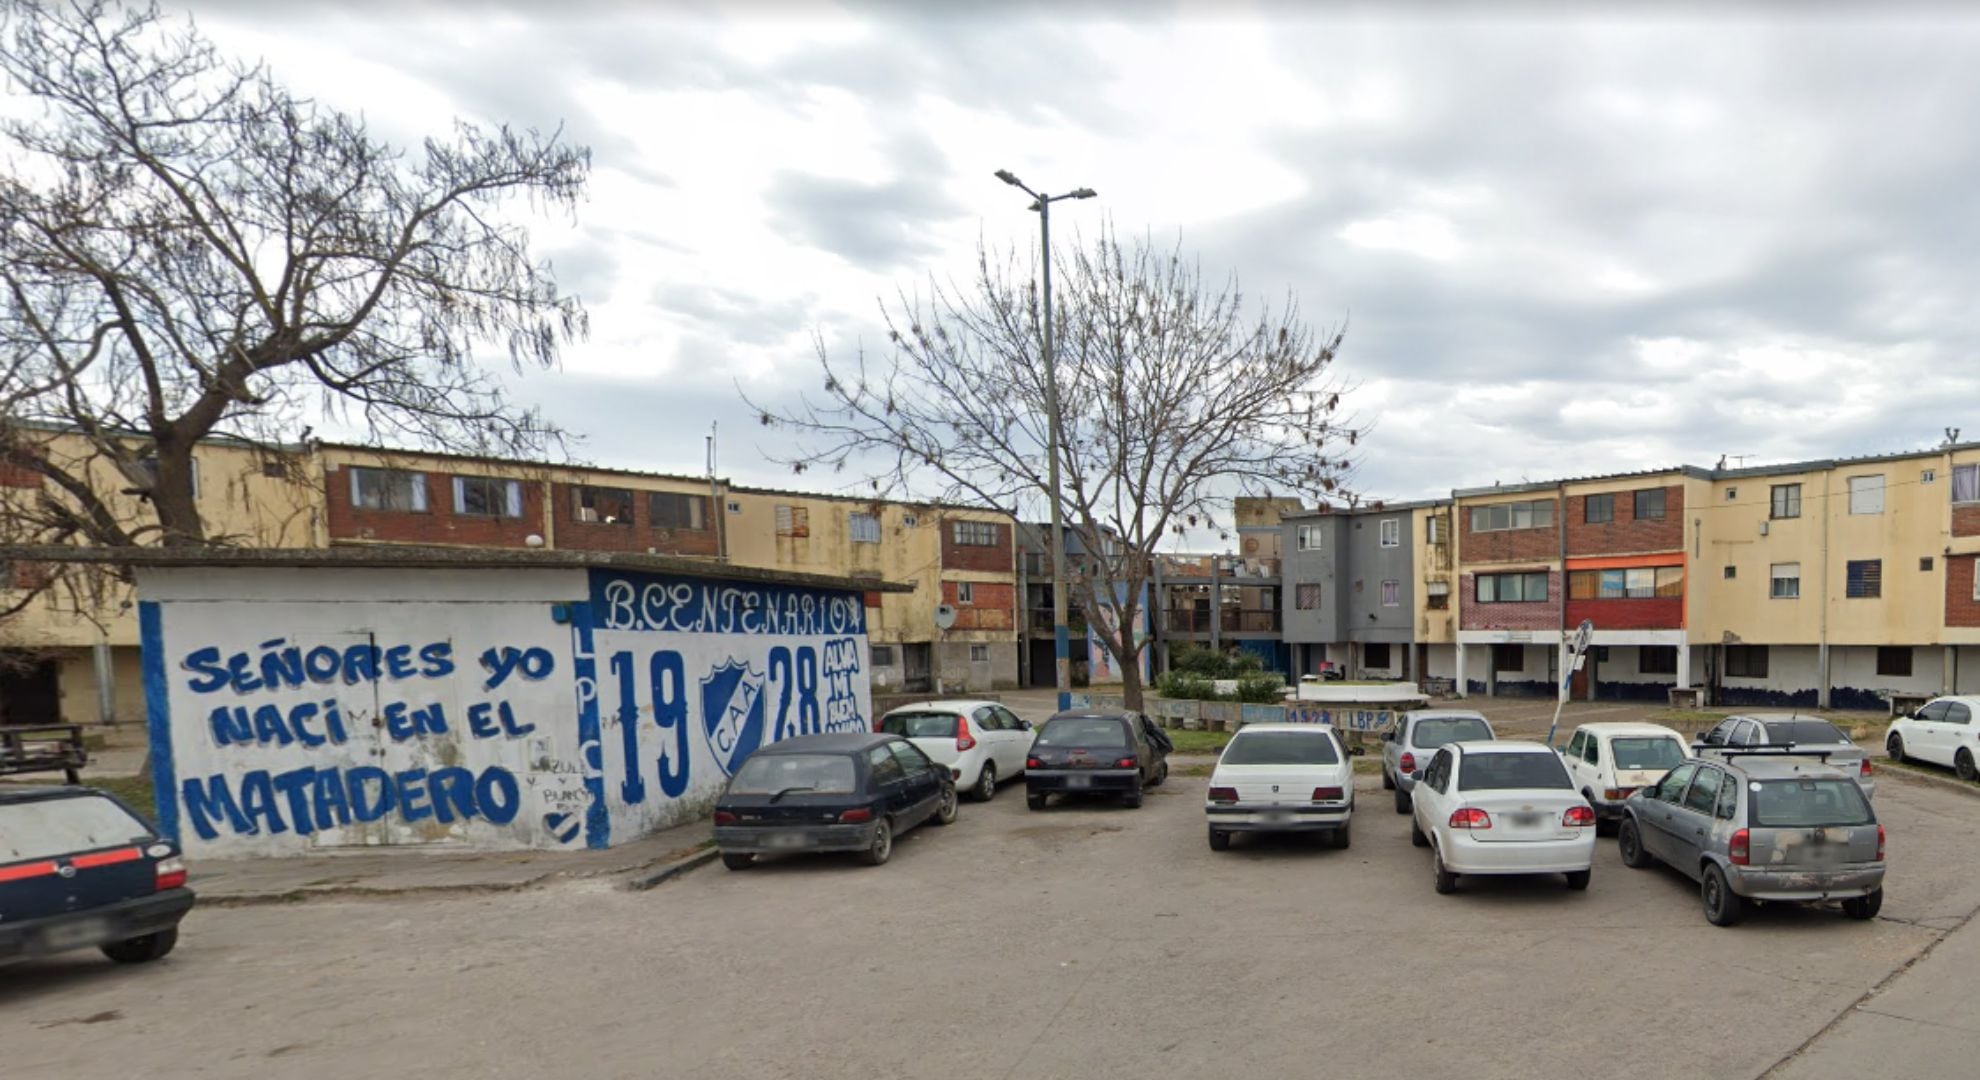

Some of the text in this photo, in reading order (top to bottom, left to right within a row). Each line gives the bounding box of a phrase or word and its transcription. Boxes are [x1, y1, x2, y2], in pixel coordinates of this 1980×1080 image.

[605, 580, 847, 634] B.CENTENARIO
[183, 638, 455, 694] SEÑORES
[384, 702, 448, 743] EN
[467, 700, 535, 739] EL
[183, 766, 521, 841] MATADERO
